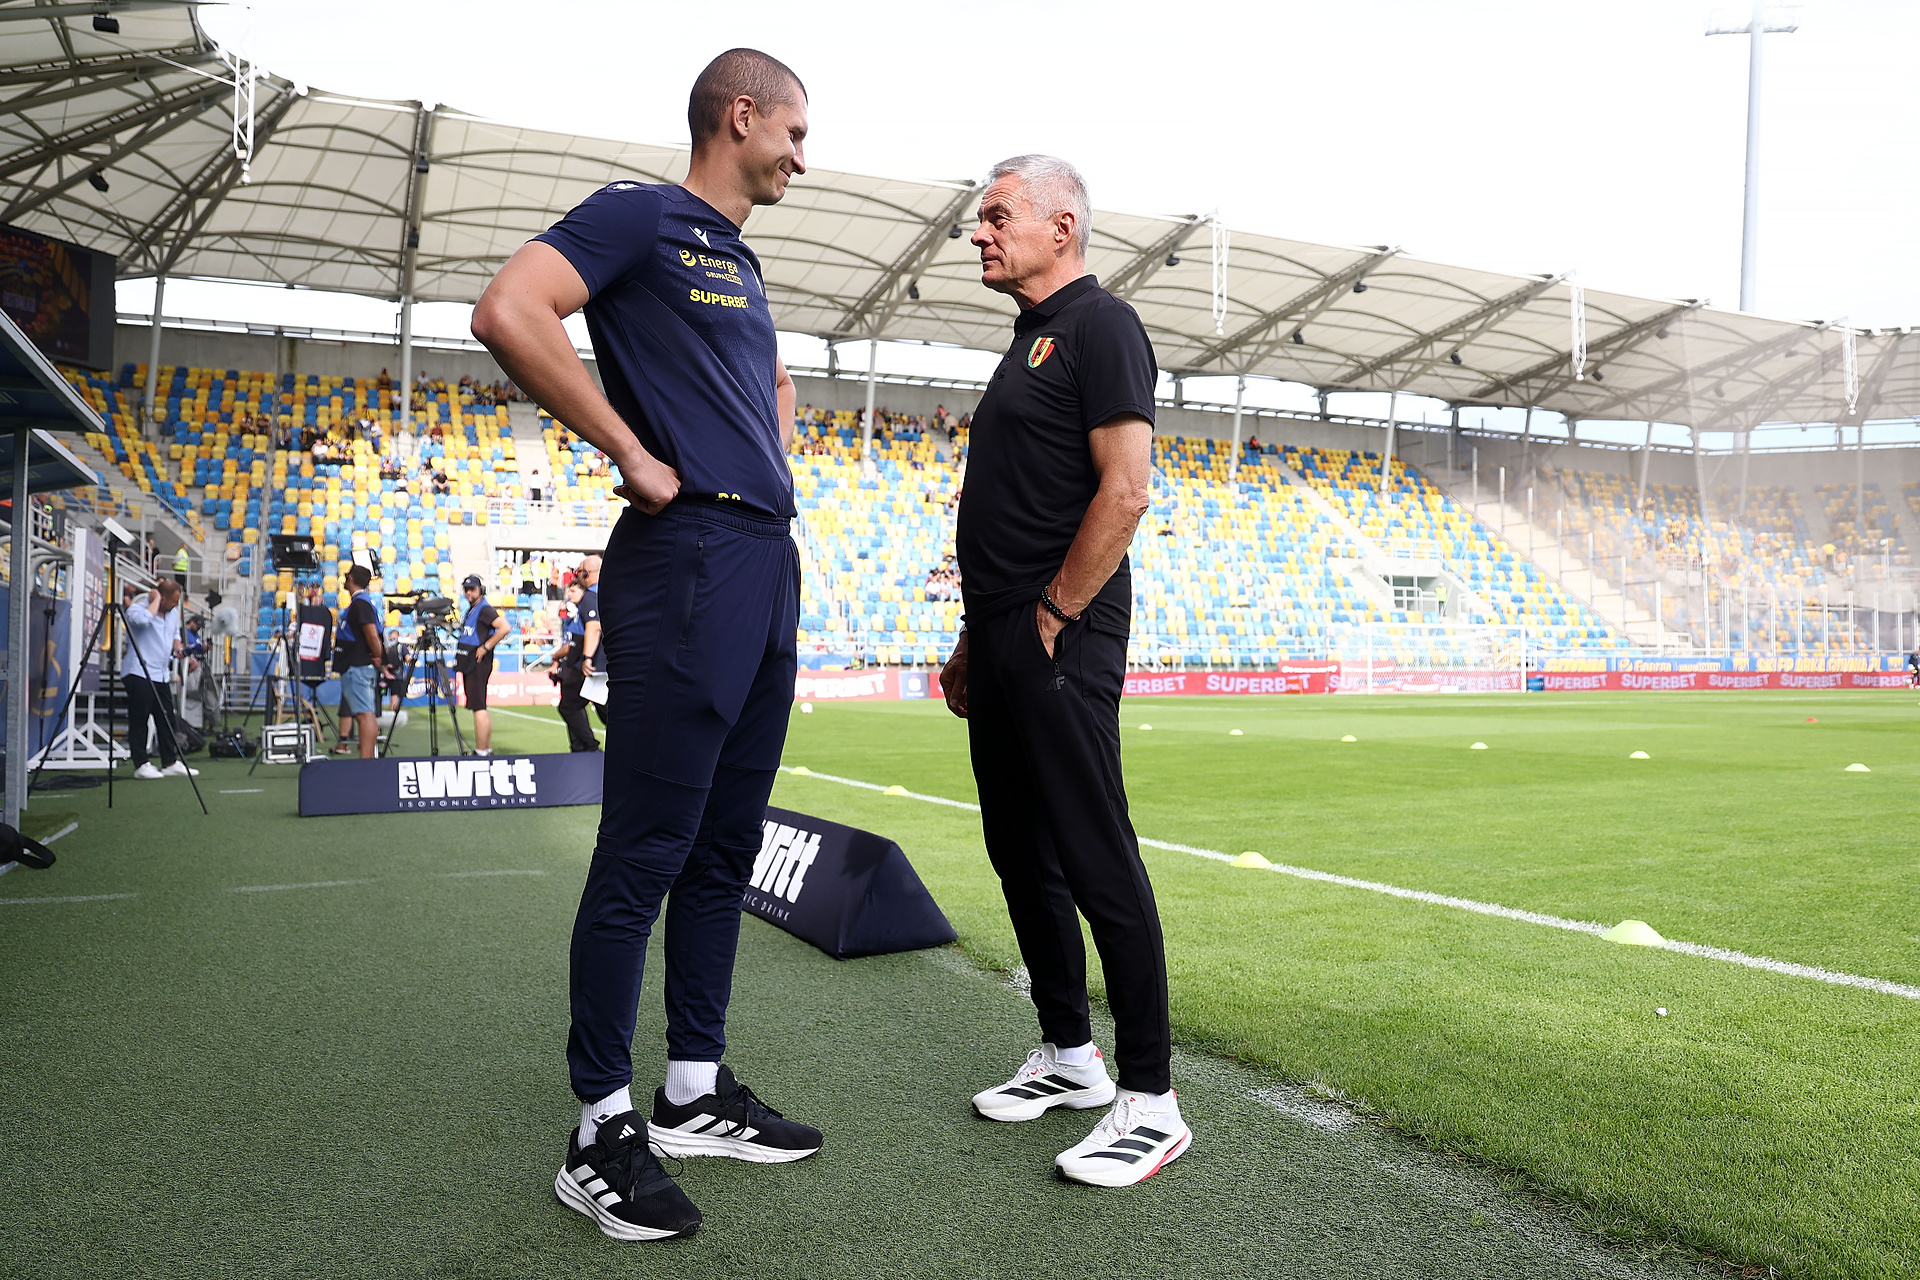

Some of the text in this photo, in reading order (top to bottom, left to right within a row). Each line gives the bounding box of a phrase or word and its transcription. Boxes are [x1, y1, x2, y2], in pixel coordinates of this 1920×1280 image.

[698, 254, 739, 274] Energa
[689, 288, 749, 309] SUPERBET
[1621, 673, 1697, 689] SUPERBET
[1708, 673, 1770, 688] SUPERBET
[1779, 673, 1843, 688] SUPERBET
[415, 758, 537, 798] Witt
[399, 797, 536, 808] ISOTONIC DRINK
[761, 901, 790, 921] DRINK
